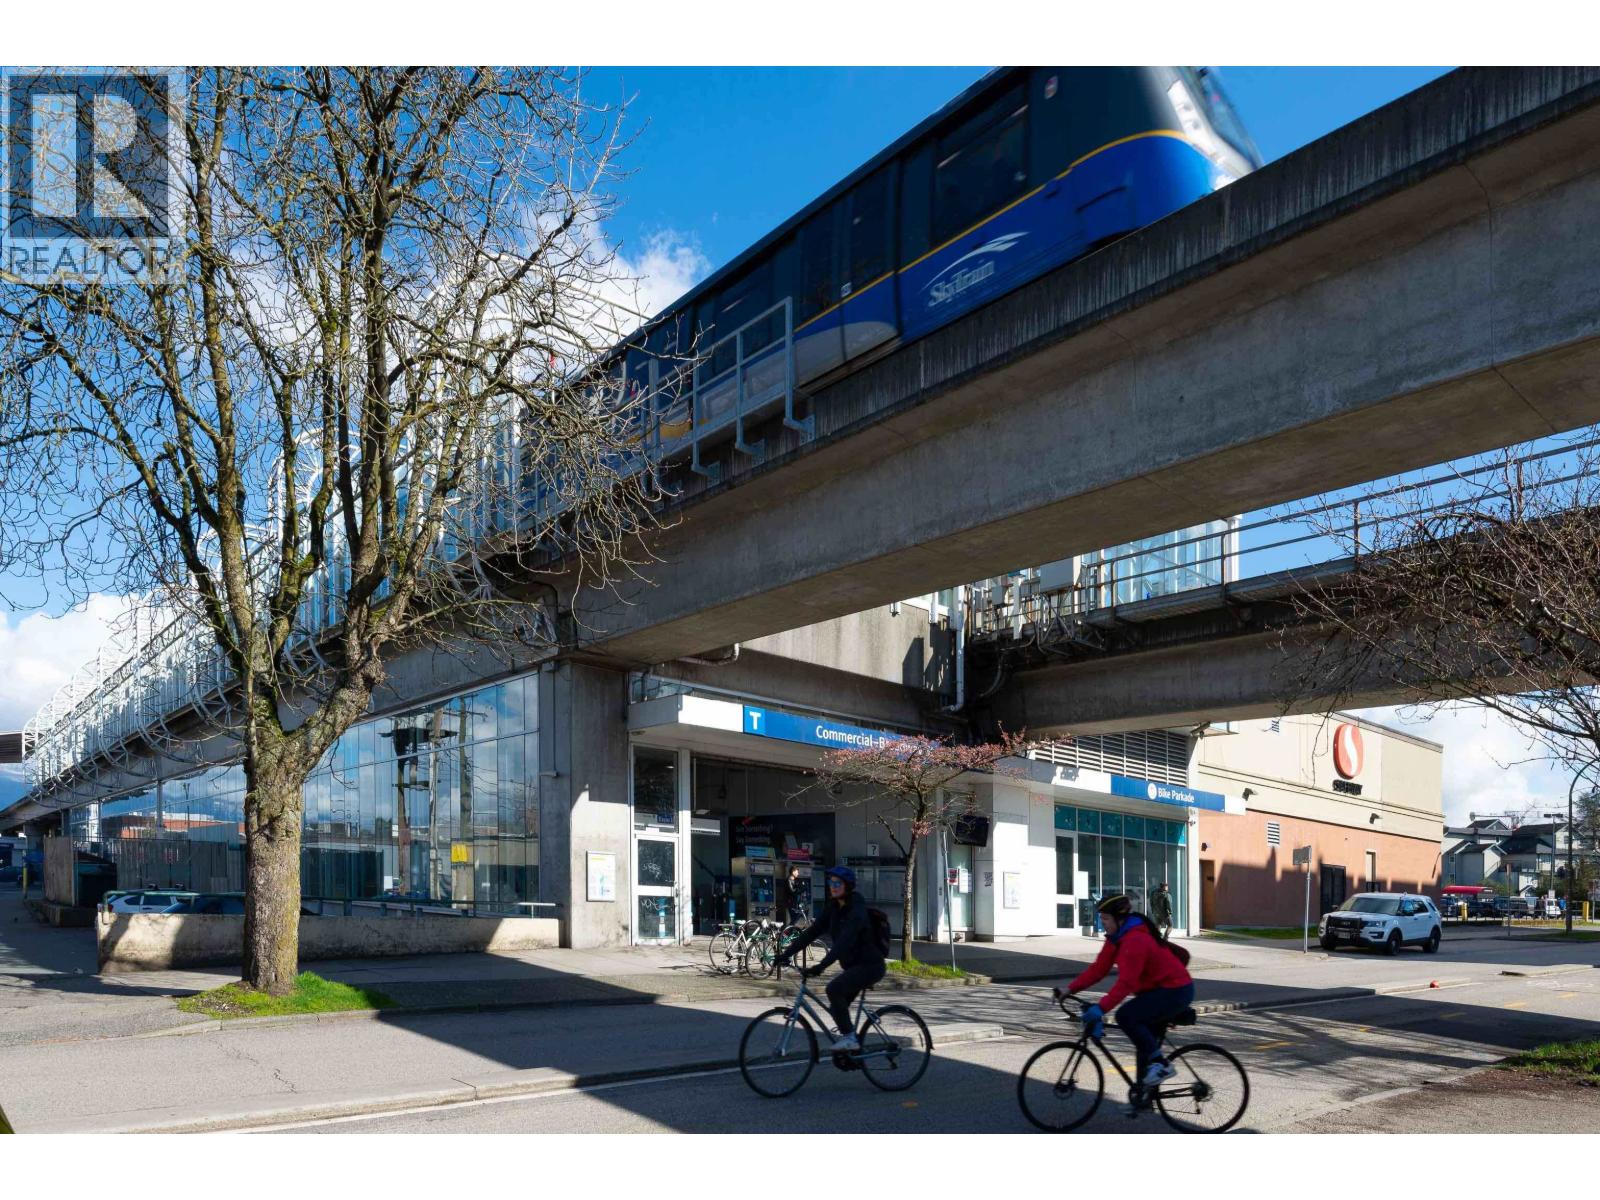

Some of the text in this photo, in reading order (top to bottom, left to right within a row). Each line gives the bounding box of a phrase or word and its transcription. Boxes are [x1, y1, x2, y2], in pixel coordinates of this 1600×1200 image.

[749, 711, 761, 730] T
[1158, 787, 1195, 803] Bike Parkade
